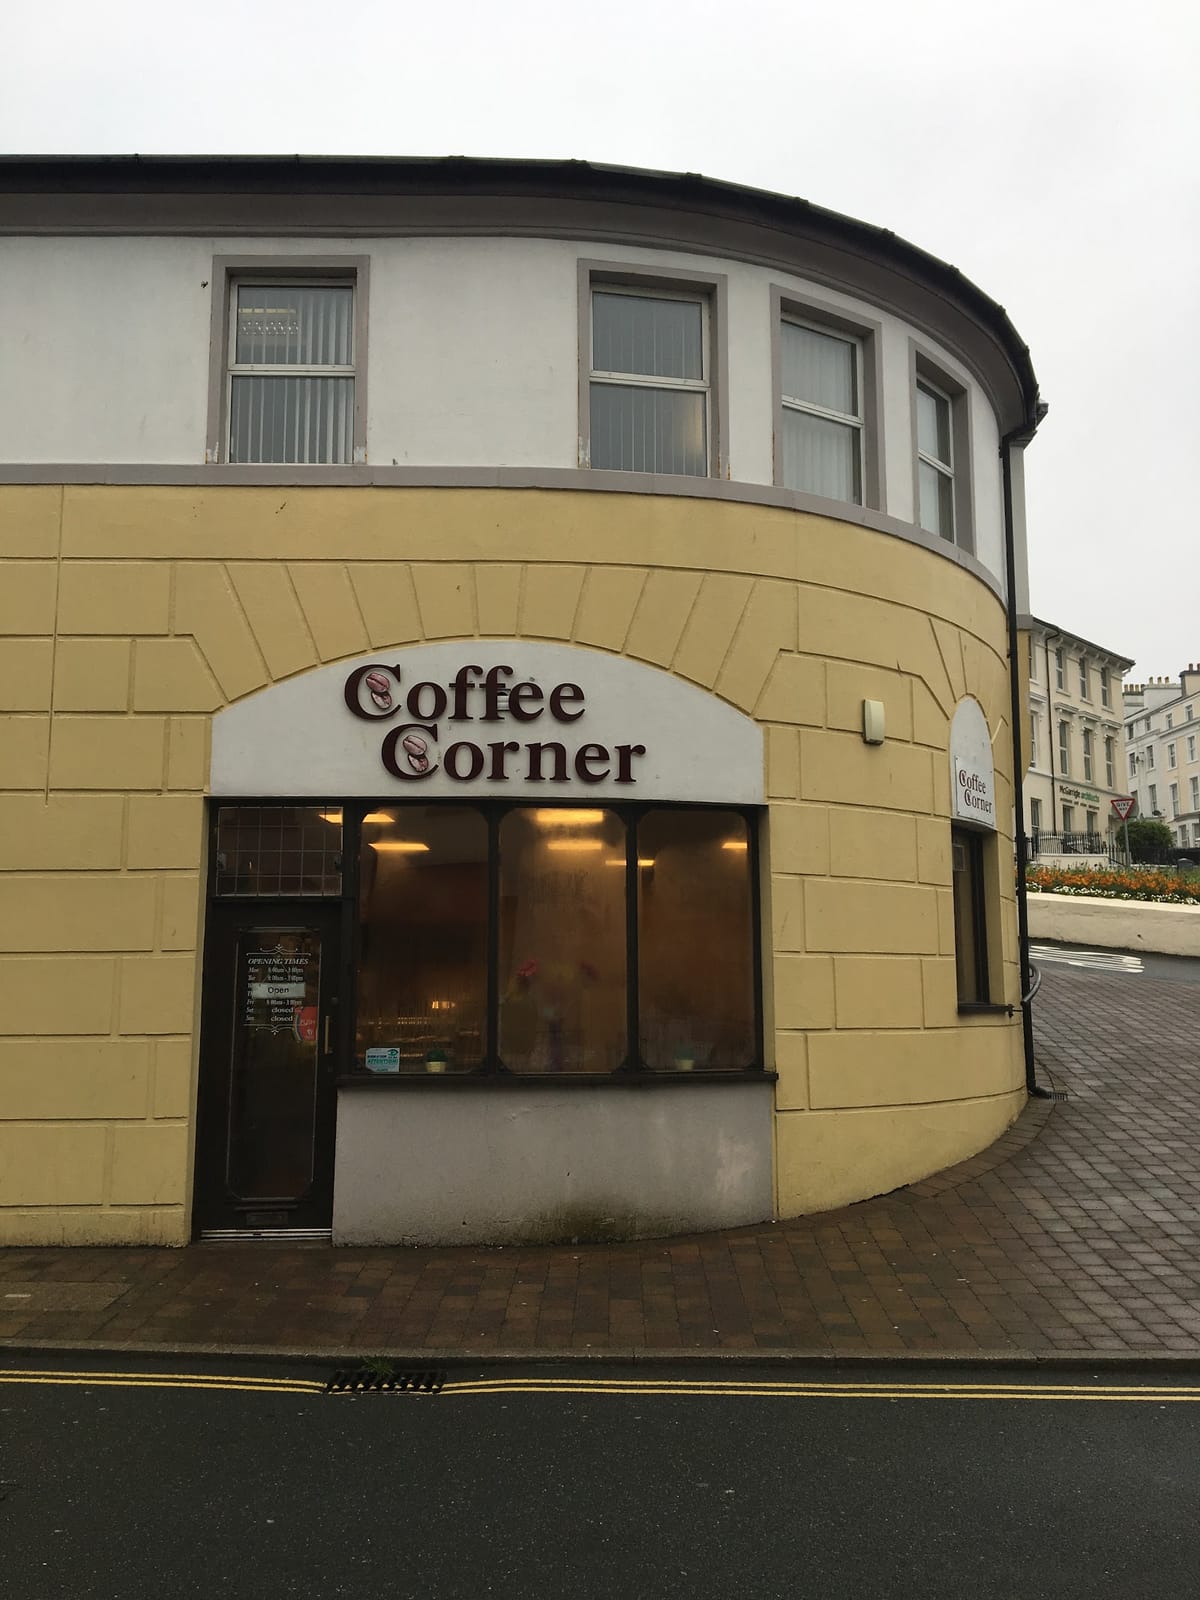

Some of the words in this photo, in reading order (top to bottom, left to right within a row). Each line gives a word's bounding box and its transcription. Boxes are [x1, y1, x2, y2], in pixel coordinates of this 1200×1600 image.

[344, 663, 586, 722] Coffee
[381, 723, 647, 783] Corner
[959, 769, 986, 794] Coffee
[964, 788, 992, 814] Corner
[267, 987, 290, 995] Open
